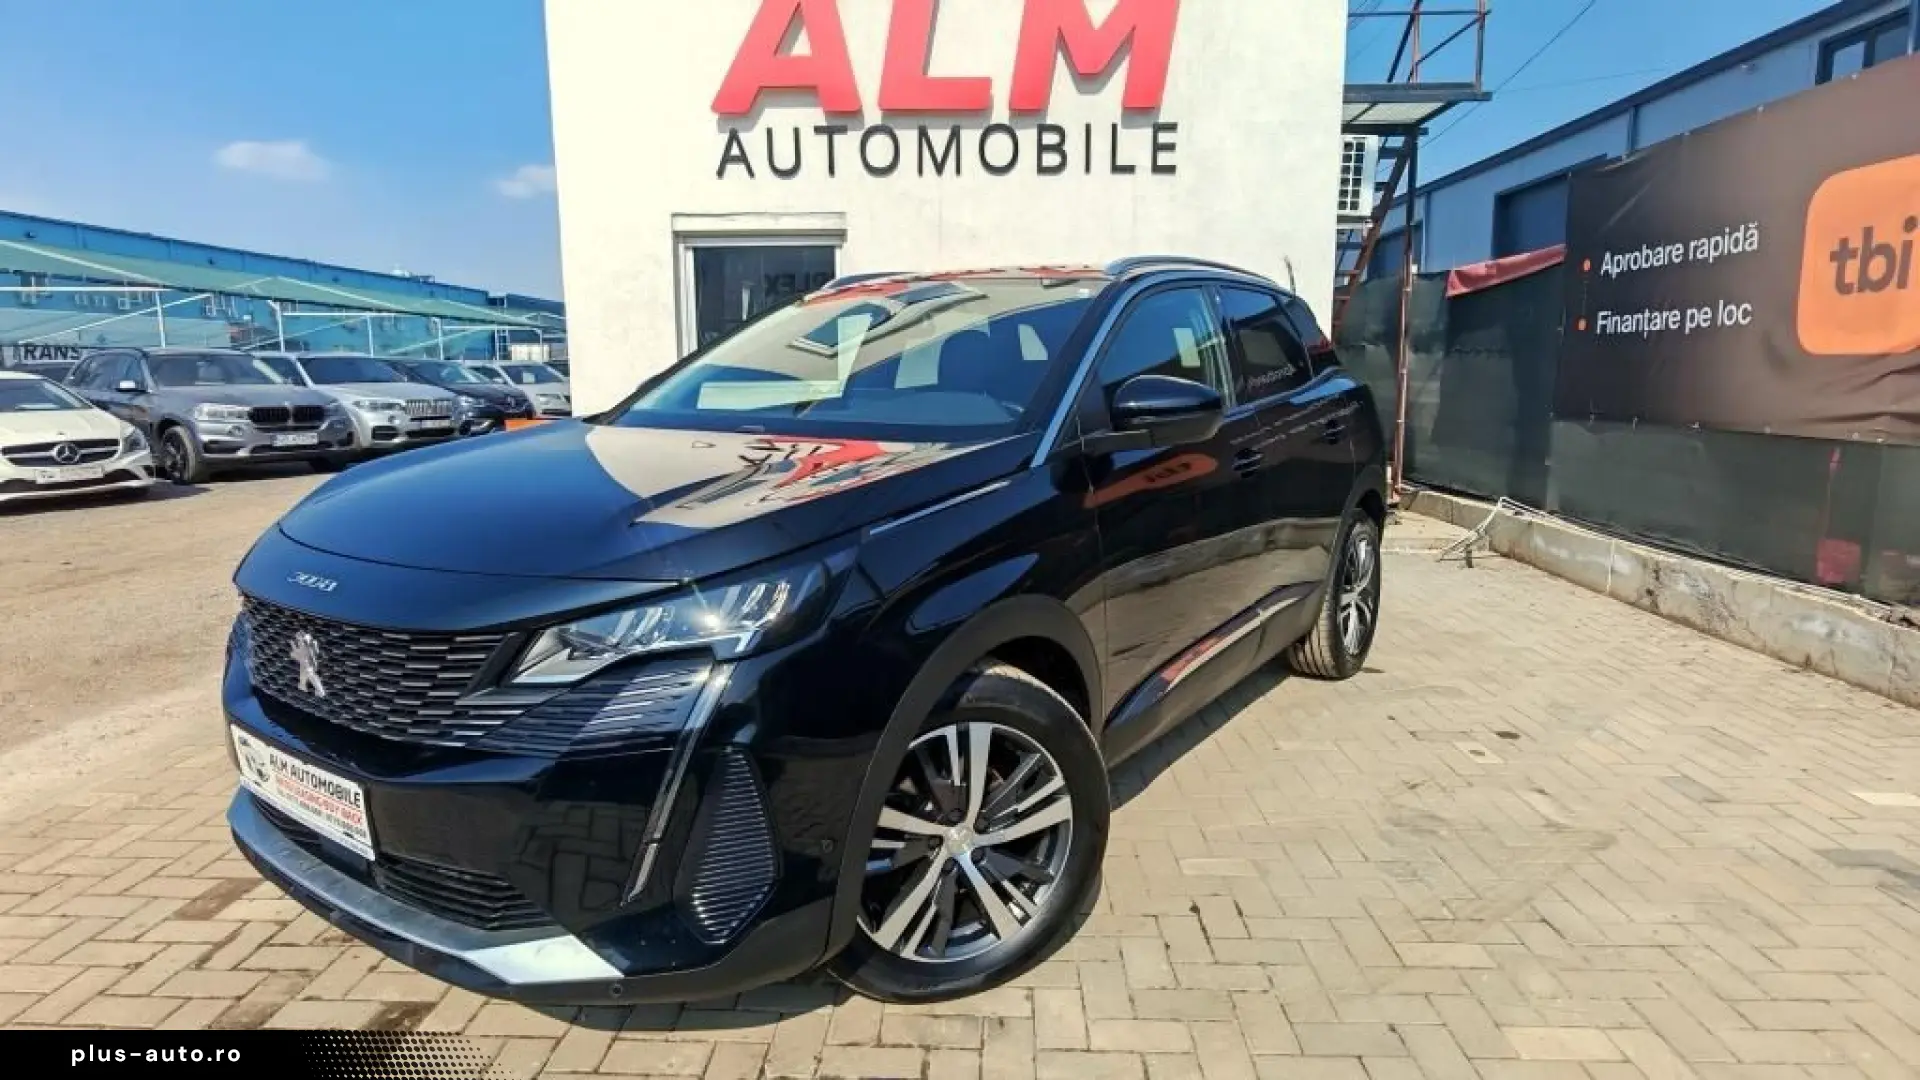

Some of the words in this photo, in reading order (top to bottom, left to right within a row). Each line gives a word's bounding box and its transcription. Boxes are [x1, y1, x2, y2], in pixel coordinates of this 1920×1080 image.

[711, 0, 1181, 114] ALM
[716, 121, 1178, 179] AUTOMOBILE
[1601, 242, 1685, 280] Aprobare
[1688, 221, 1759, 263] rapidă
[1829, 215, 1918, 294] tbi
[1596, 308, 1681, 340] Finanțare
[1684, 305, 1713, 335] pe
[1717, 299, 1753, 327] loc
[290, 764, 361, 808] AUTOMOBILE
